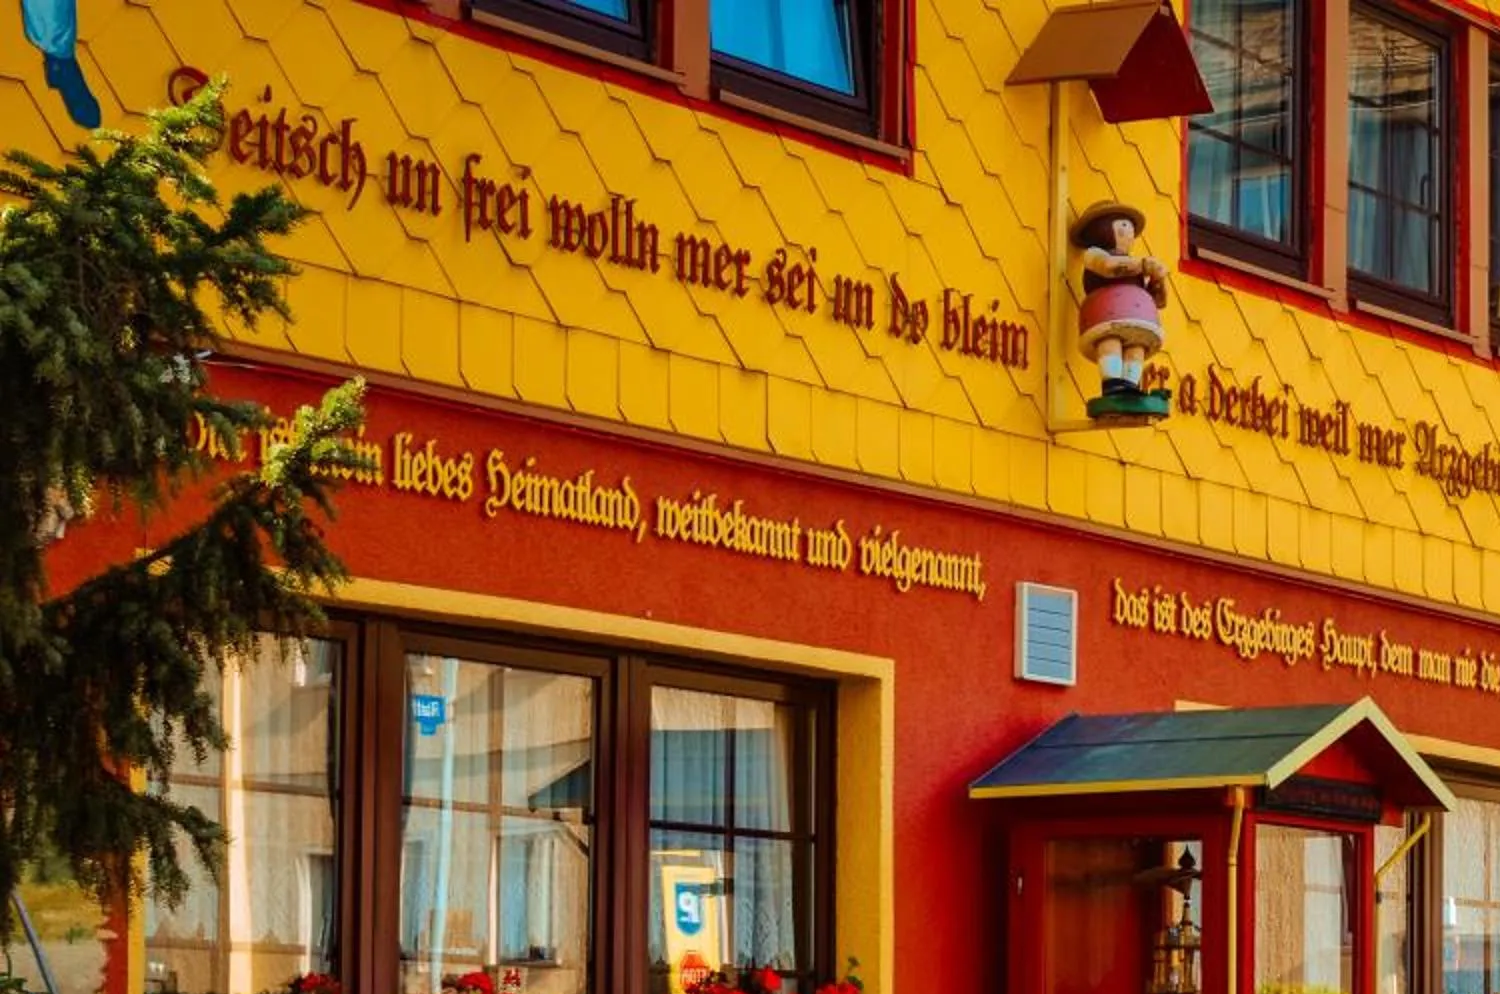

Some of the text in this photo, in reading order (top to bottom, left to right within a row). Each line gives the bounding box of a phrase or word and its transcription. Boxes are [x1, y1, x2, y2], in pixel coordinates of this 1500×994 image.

[385, 150, 442, 217] un
[462, 153, 533, 243] frei
[547, 192, 660, 274] wolln
[673, 230, 751, 298] mer
[764, 246, 819, 315] sei
[832, 272, 875, 331] un
[1178, 372, 1198, 417] a
[1206, 362, 1291, 440] derbei
[1299, 401, 1350, 457] weil
[1358, 420, 1406, 472] mer
[393, 431, 473, 500] liebes
[486, 447, 647, 543] Heimatland,
[656, 492, 802, 561] weitbekannt
[806, 519, 852, 571] und
[860, 522, 987, 602] vielgenannt,
[1153, 584, 1177, 633] ist
[1181, 591, 1212, 641] des
[1319, 617, 1377, 679] Haupt,
[1380, 628, 1413, 677] dem
[1419, 647, 1451, 686] man
[1455, 646, 1477, 690] nie
